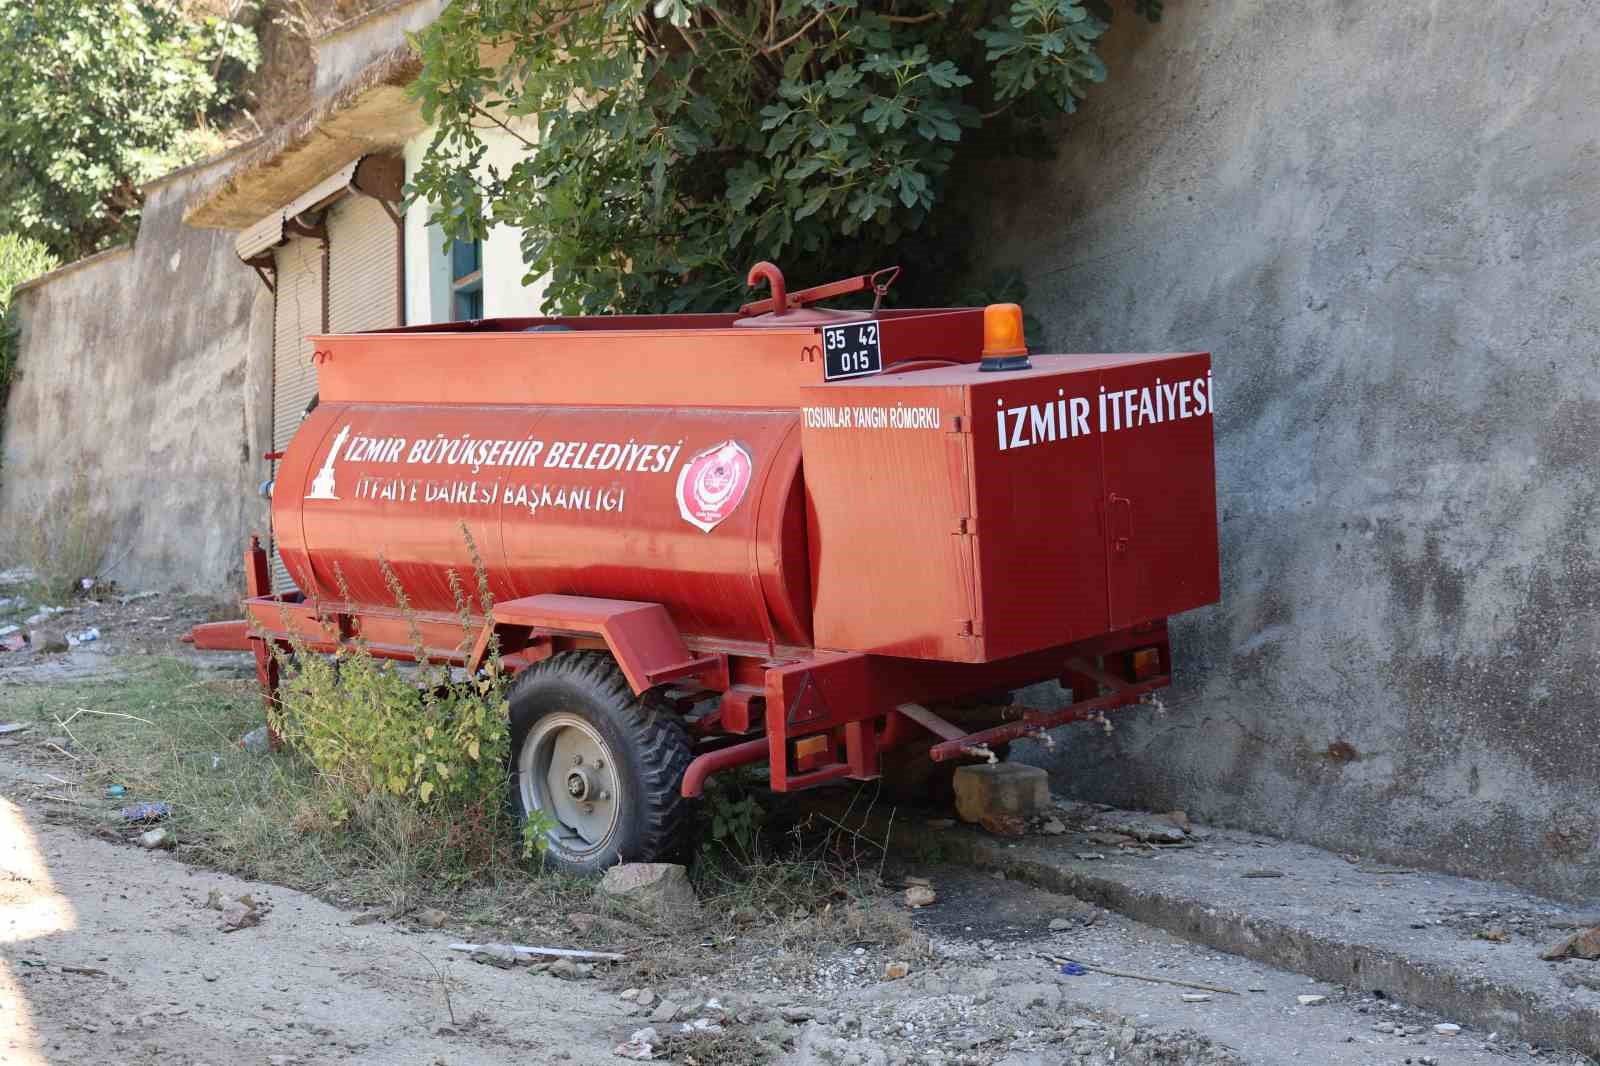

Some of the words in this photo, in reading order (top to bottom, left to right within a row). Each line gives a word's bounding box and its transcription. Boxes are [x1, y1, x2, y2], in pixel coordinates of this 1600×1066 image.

[826, 329, 846, 350] 35
[858, 325, 877, 346] 42
[841, 350, 870, 372] 015
[802, 407, 851, 429] TOSUNLAR
[852, 407, 888, 429] YANGIN
[889, 401, 941, 430] RÖMORKU
[996, 387, 1092, 451] İZMİR
[1098, 369, 1214, 433] İTFAİYESİ
[343, 431, 406, 464] İZMİR
[406, 433, 544, 474] BÜYÜKŞEHİR
[543, 437, 683, 473] BELEDİYESİ
